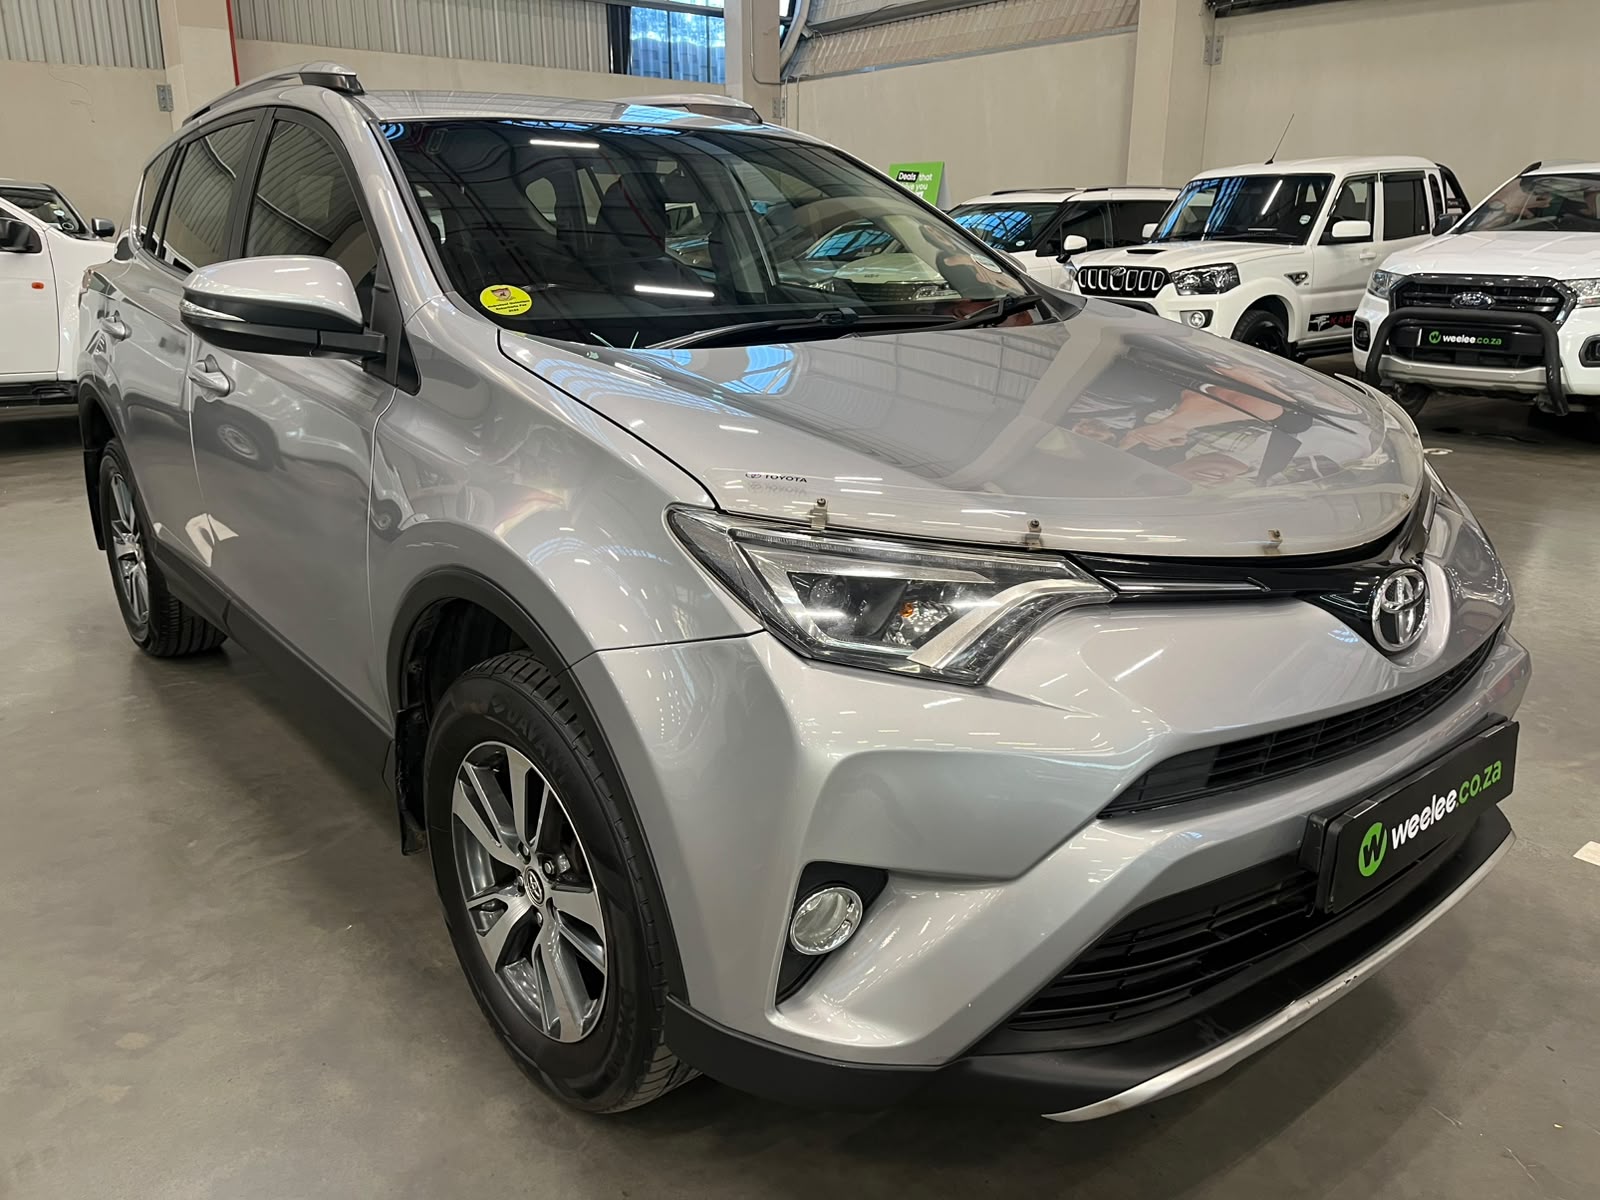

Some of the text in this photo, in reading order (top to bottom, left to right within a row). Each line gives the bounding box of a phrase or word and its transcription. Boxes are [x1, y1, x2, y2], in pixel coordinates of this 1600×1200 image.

[898, 172, 932, 181] Deals that
[915, 183, 929, 192] you
[1443, 334, 1502, 345] weelee.co.za
[765, 474, 807, 483] TOYOTA
[1391, 760, 1502, 850] weelee.co.za
